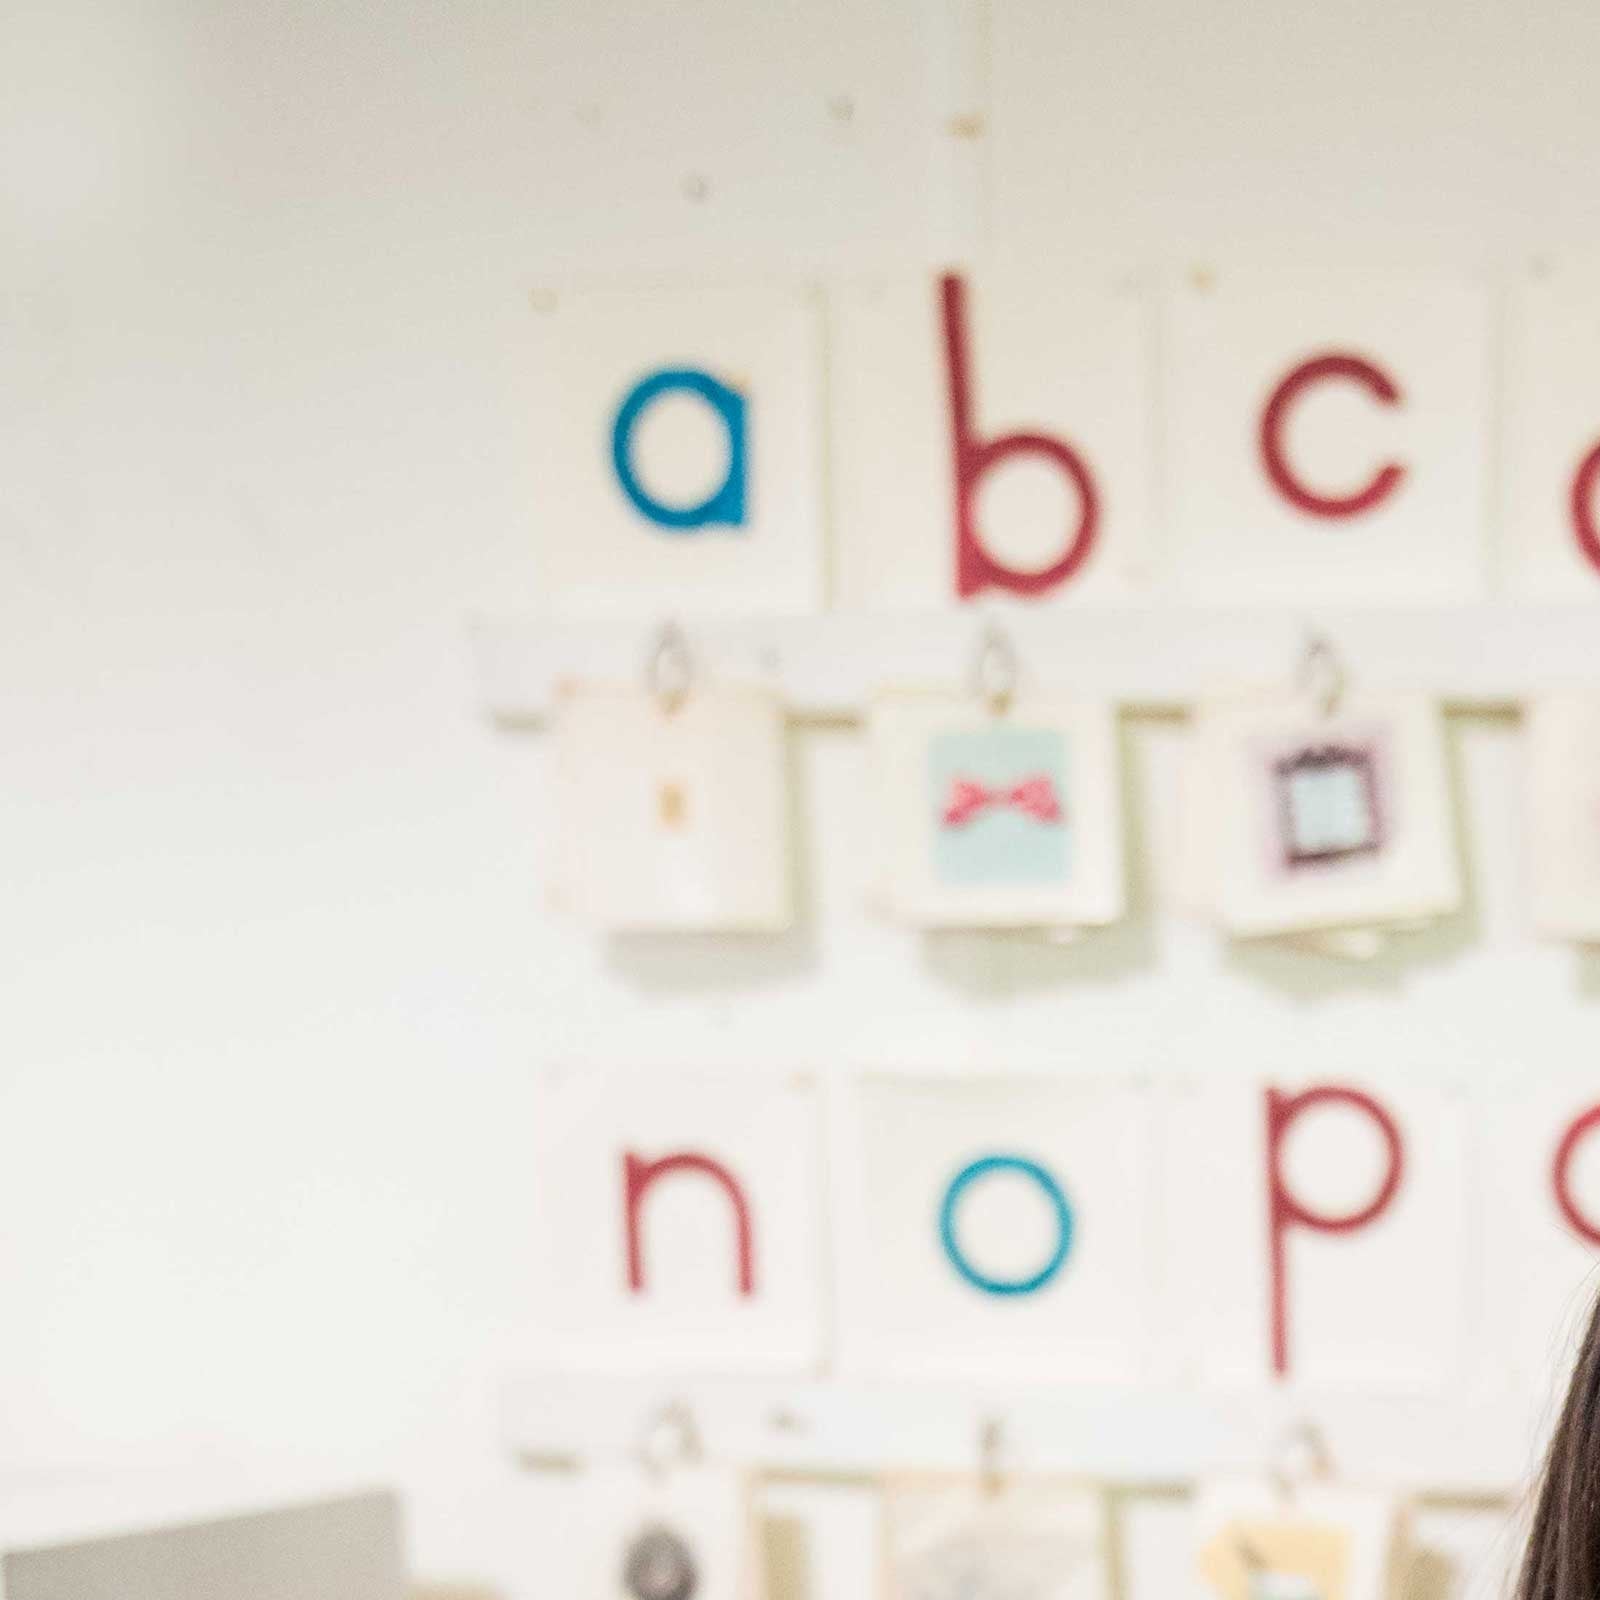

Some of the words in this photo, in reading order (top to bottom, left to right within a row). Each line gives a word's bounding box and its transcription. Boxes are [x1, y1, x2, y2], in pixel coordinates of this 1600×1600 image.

[609, 368, 749, 532] a
[939, 272, 1102, 600] b
[1257, 353, 1405, 521] c
[622, 1149, 754, 1297] n
[938, 1153, 1075, 1297] o
[1265, 1084, 1405, 1378] p
